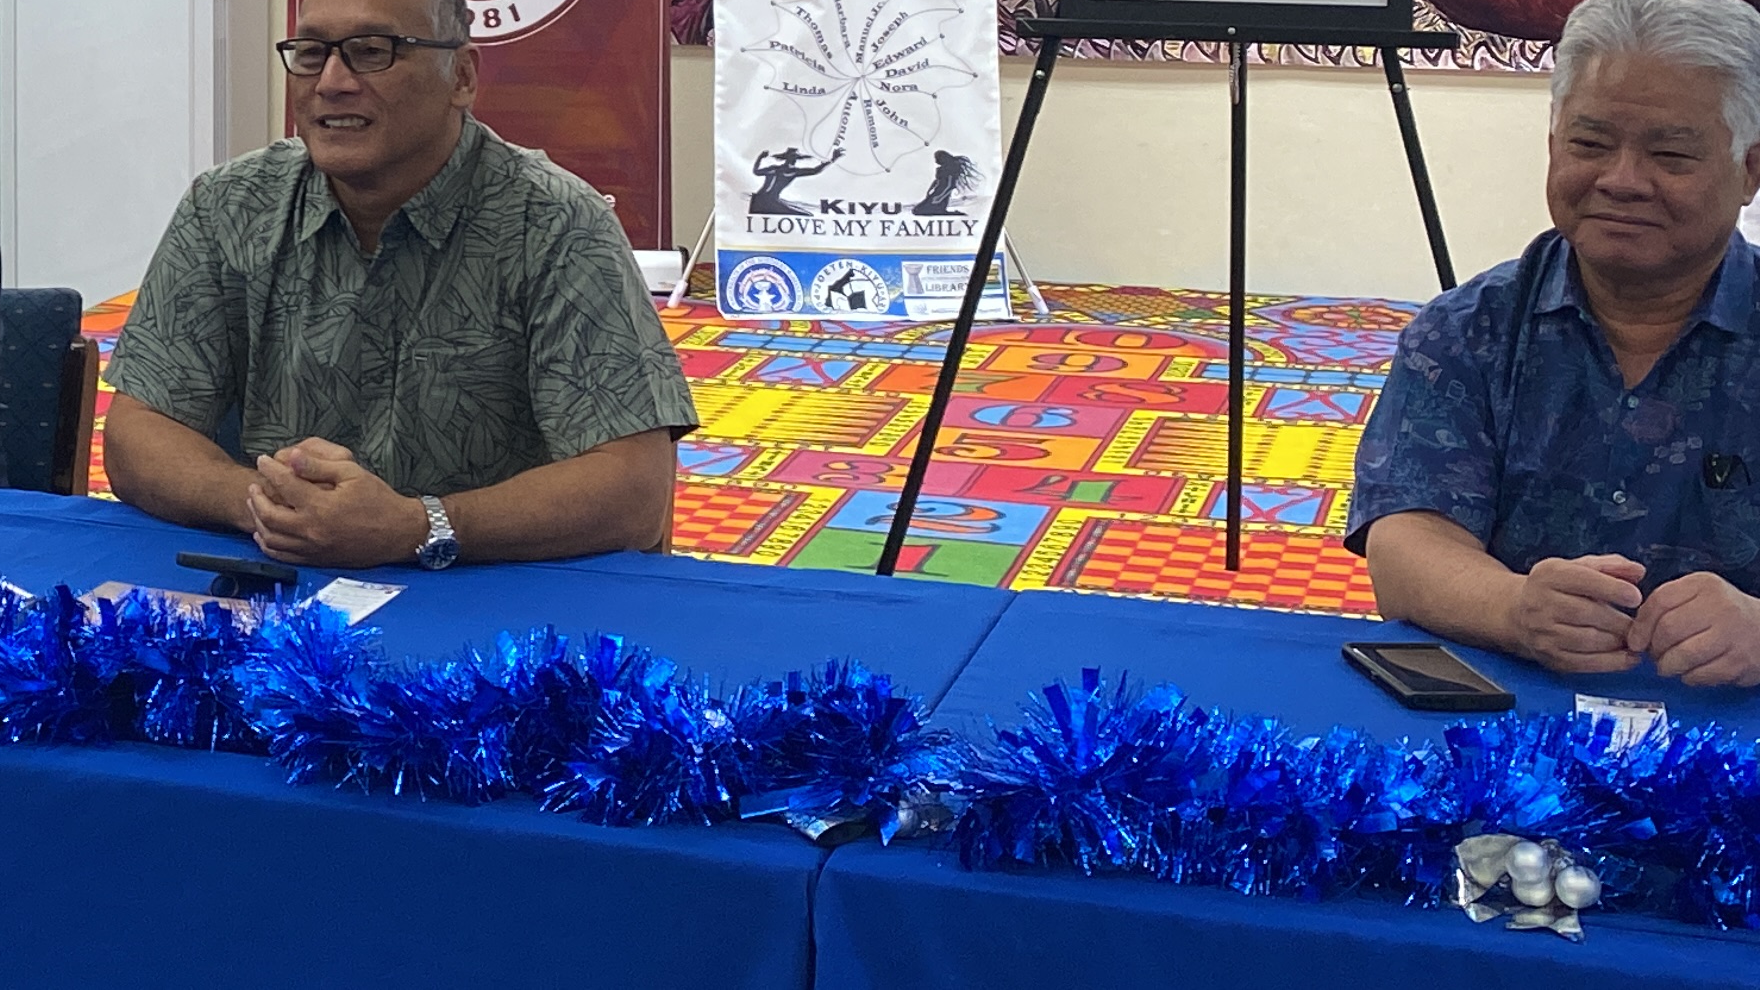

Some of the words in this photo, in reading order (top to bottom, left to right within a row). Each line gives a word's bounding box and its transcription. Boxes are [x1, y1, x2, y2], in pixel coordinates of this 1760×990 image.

[796, 5, 833, 60] Thomas
[856, 17, 873, 64] Manuel
[870, 11, 909, 53] Joseph
[769, 40, 826, 73] Patricia
[872, 36, 928, 70] Edward
[885, 58, 930, 78] David
[782, 82, 826, 95] Linda
[880, 81, 918, 93] Nora
[833, 91, 859, 147] Antonia
[863, 99, 879, 149] Ramona
[875, 99, 909, 128] John
[820, 199, 902, 215] KIYU
[746, 216, 753, 233] I
[762, 218, 827, 236] LOVE
[832, 219, 872, 236] MY
[879, 219, 979, 237] FAMILY
[926, 264, 970, 275] FRIENDS
[925, 283, 968, 292] LIBRAR
[970, 404, 1079, 429] 6
[934, 432, 1052, 461] 5
[1016, 474, 1143, 504] 4
